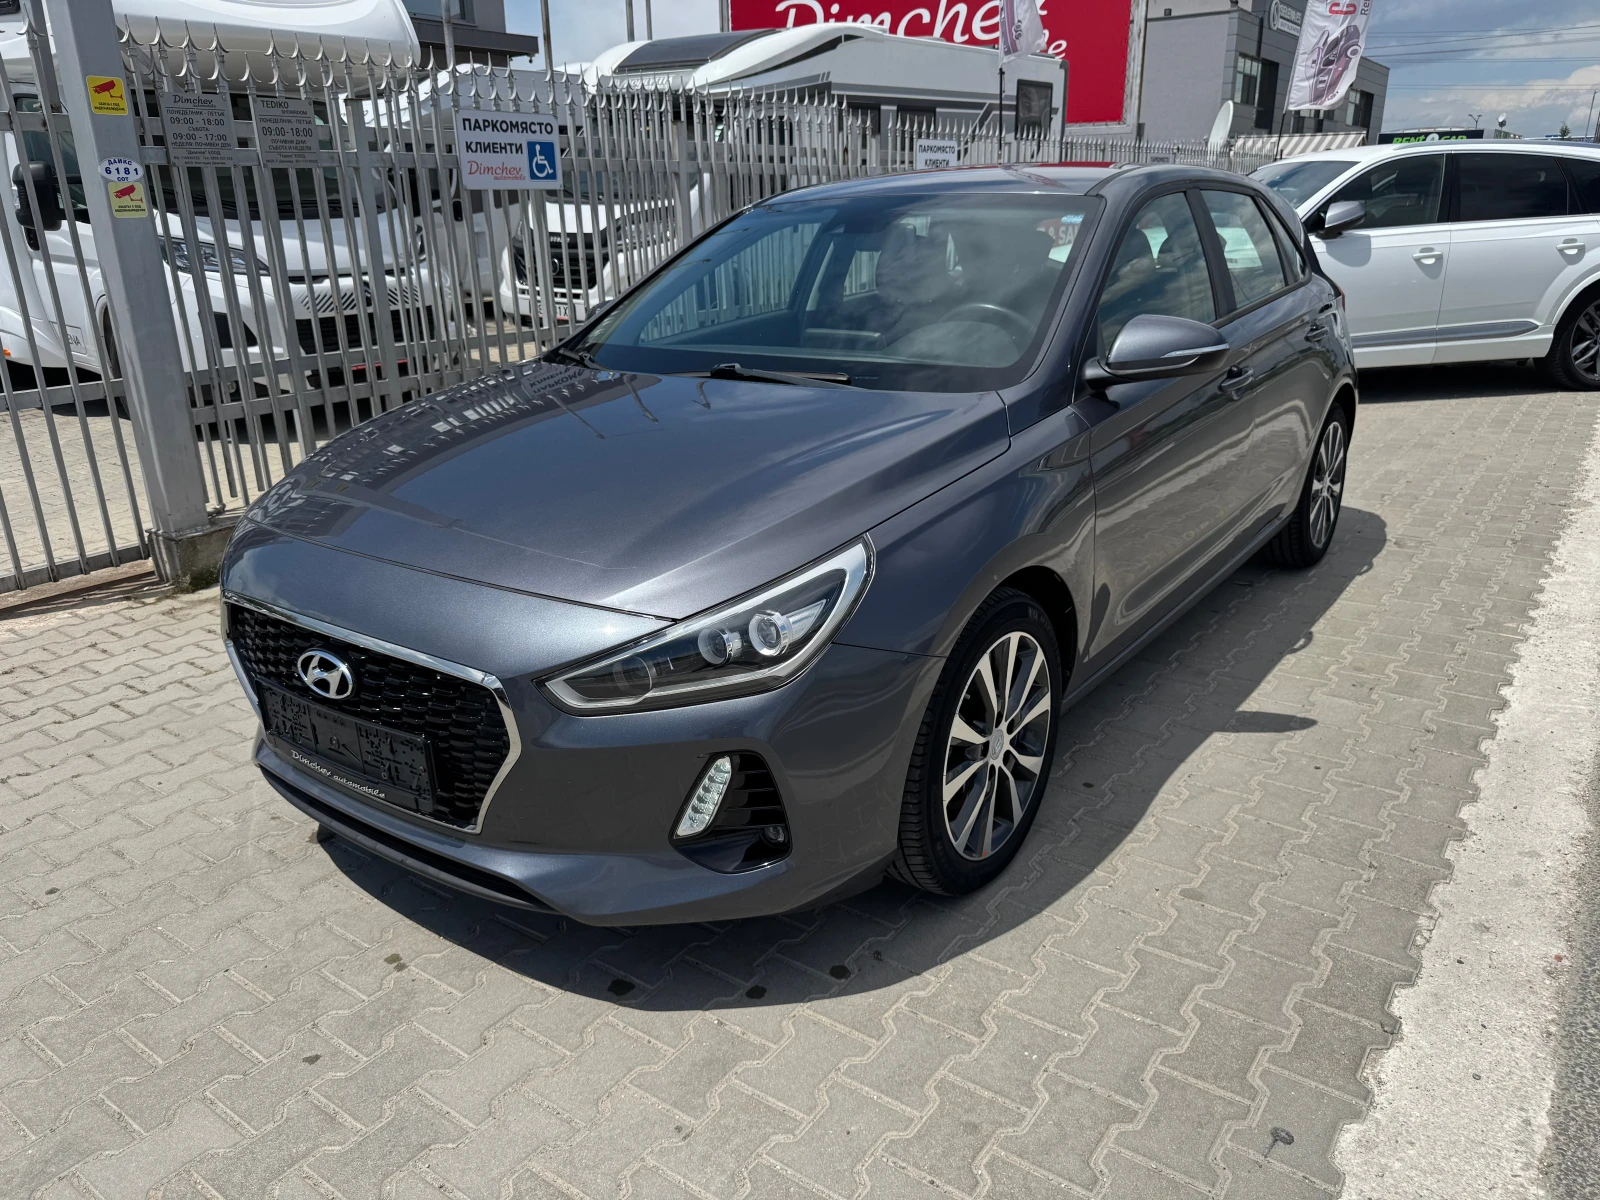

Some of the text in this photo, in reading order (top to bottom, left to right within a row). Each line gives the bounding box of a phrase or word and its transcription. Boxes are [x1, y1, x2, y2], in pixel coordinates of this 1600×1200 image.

[172, 94, 213, 105] Dimchev
[260, 100, 288, 109] TEDIKO
[462, 118, 553, 135] ПАРКОМЯСТО
[466, 141, 523, 154] КЛИЕНТИ
[919, 145, 955, 154] ПАРКОМЯСТО
[467, 160, 521, 176] Dimchev
[925, 159, 949, 168] КЛИЕНТИ
[291, 750, 385, 798] Dimchev automobile
